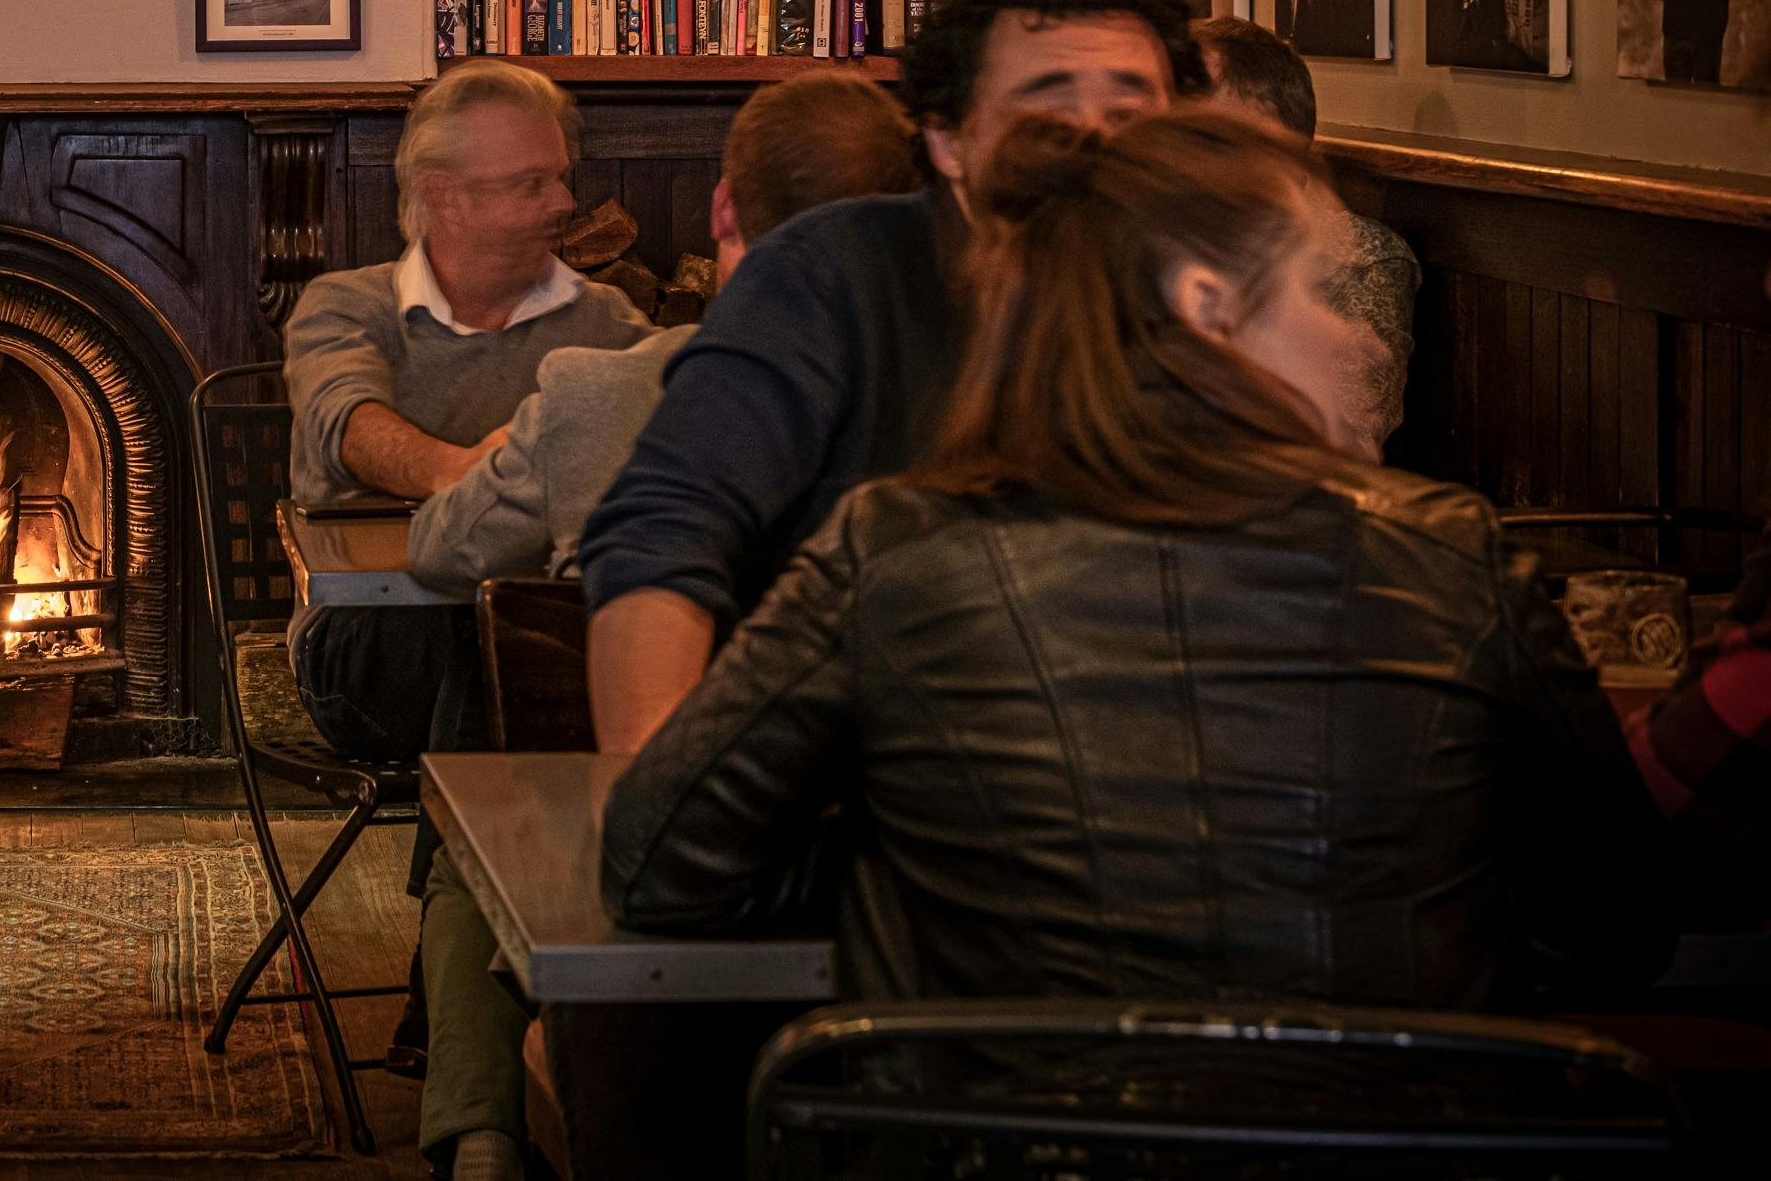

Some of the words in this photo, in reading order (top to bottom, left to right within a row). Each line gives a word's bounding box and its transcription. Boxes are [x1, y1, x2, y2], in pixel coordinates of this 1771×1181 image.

[698, 0, 707, 39] FONTEYN
[854, 3, 864, 22] 2001
[527, 14, 537, 41] GEORGE
